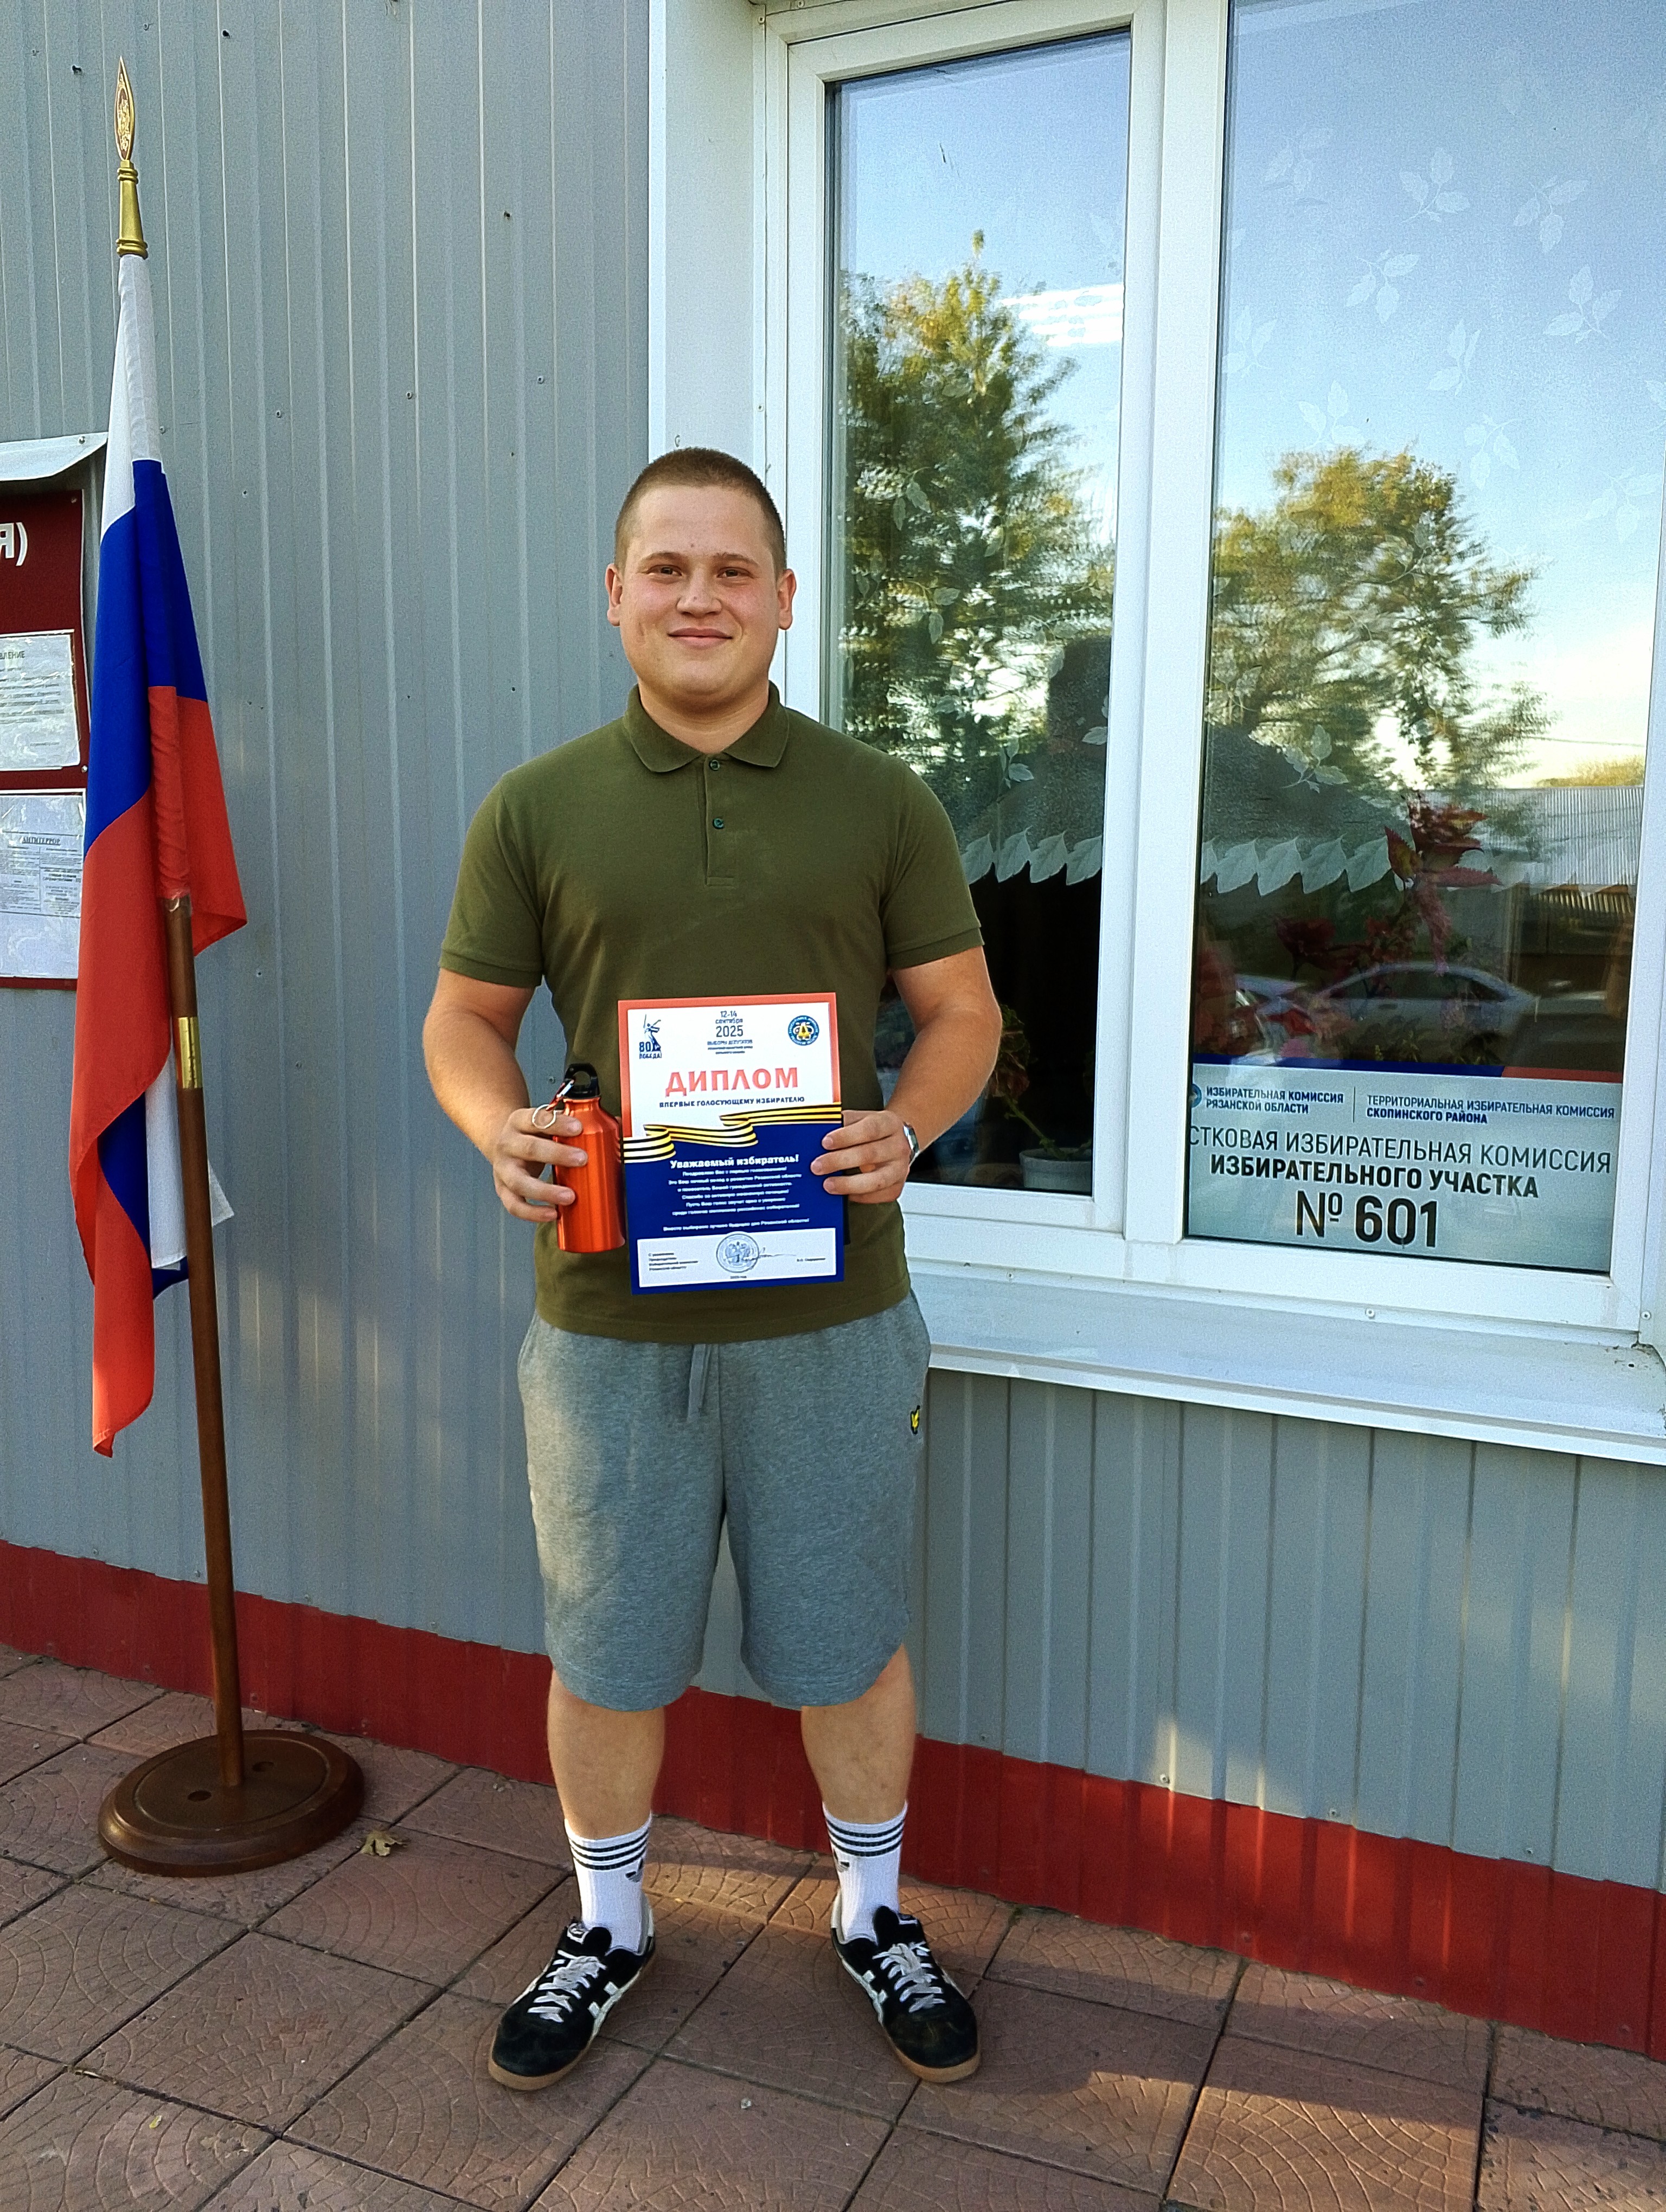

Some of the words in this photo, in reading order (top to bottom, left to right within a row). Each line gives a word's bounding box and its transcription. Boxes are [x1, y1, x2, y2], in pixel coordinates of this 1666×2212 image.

[716, 1025, 744, 1037] 2025
[639, 1041, 651, 1052] 80
[665, 1067, 798, 1097] ДИПЛОМ
[1206, 1085, 1286, 1100] ИЗБИРАТЕЛЬНАЯ
[1288, 1091, 1344, 1104] КОМИССИЯ
[1206, 1099, 1261, 1112] РЯЗАНСКОЙ
[1264, 1103, 1309, 1114] ОБЛАСТИ
[1367, 1095, 1464, 1110] ТЕРРИТОРИАЛЬНАЯ
[1466, 1101, 1552, 1115] ИЗБИРАТЕЛЬНАЯ
[1555, 1105, 1615, 1118] КОМИССИЯ
[1367, 1108, 1443, 1121] СКОПИНСКОГО
[1445, 1110, 1488, 1124] РАЙОНА
[670, 1157, 734, 1169] Уважаемый
[736, 1154, 799, 1166] избиратель!
[1286, 1131, 1472, 1164] ИЗБИРАТЕЛЬНАЯ
[1481, 1144, 1611, 1173] КОМИССИЯ
[1210, 1155, 1422, 1189] ИЗБИРАТЕЛЬНОГО
[1430, 1169, 1539, 1198] УЧАСТКА
[1296, 1190, 1343, 1237] №
[1355, 1195, 1438, 1248] 601
